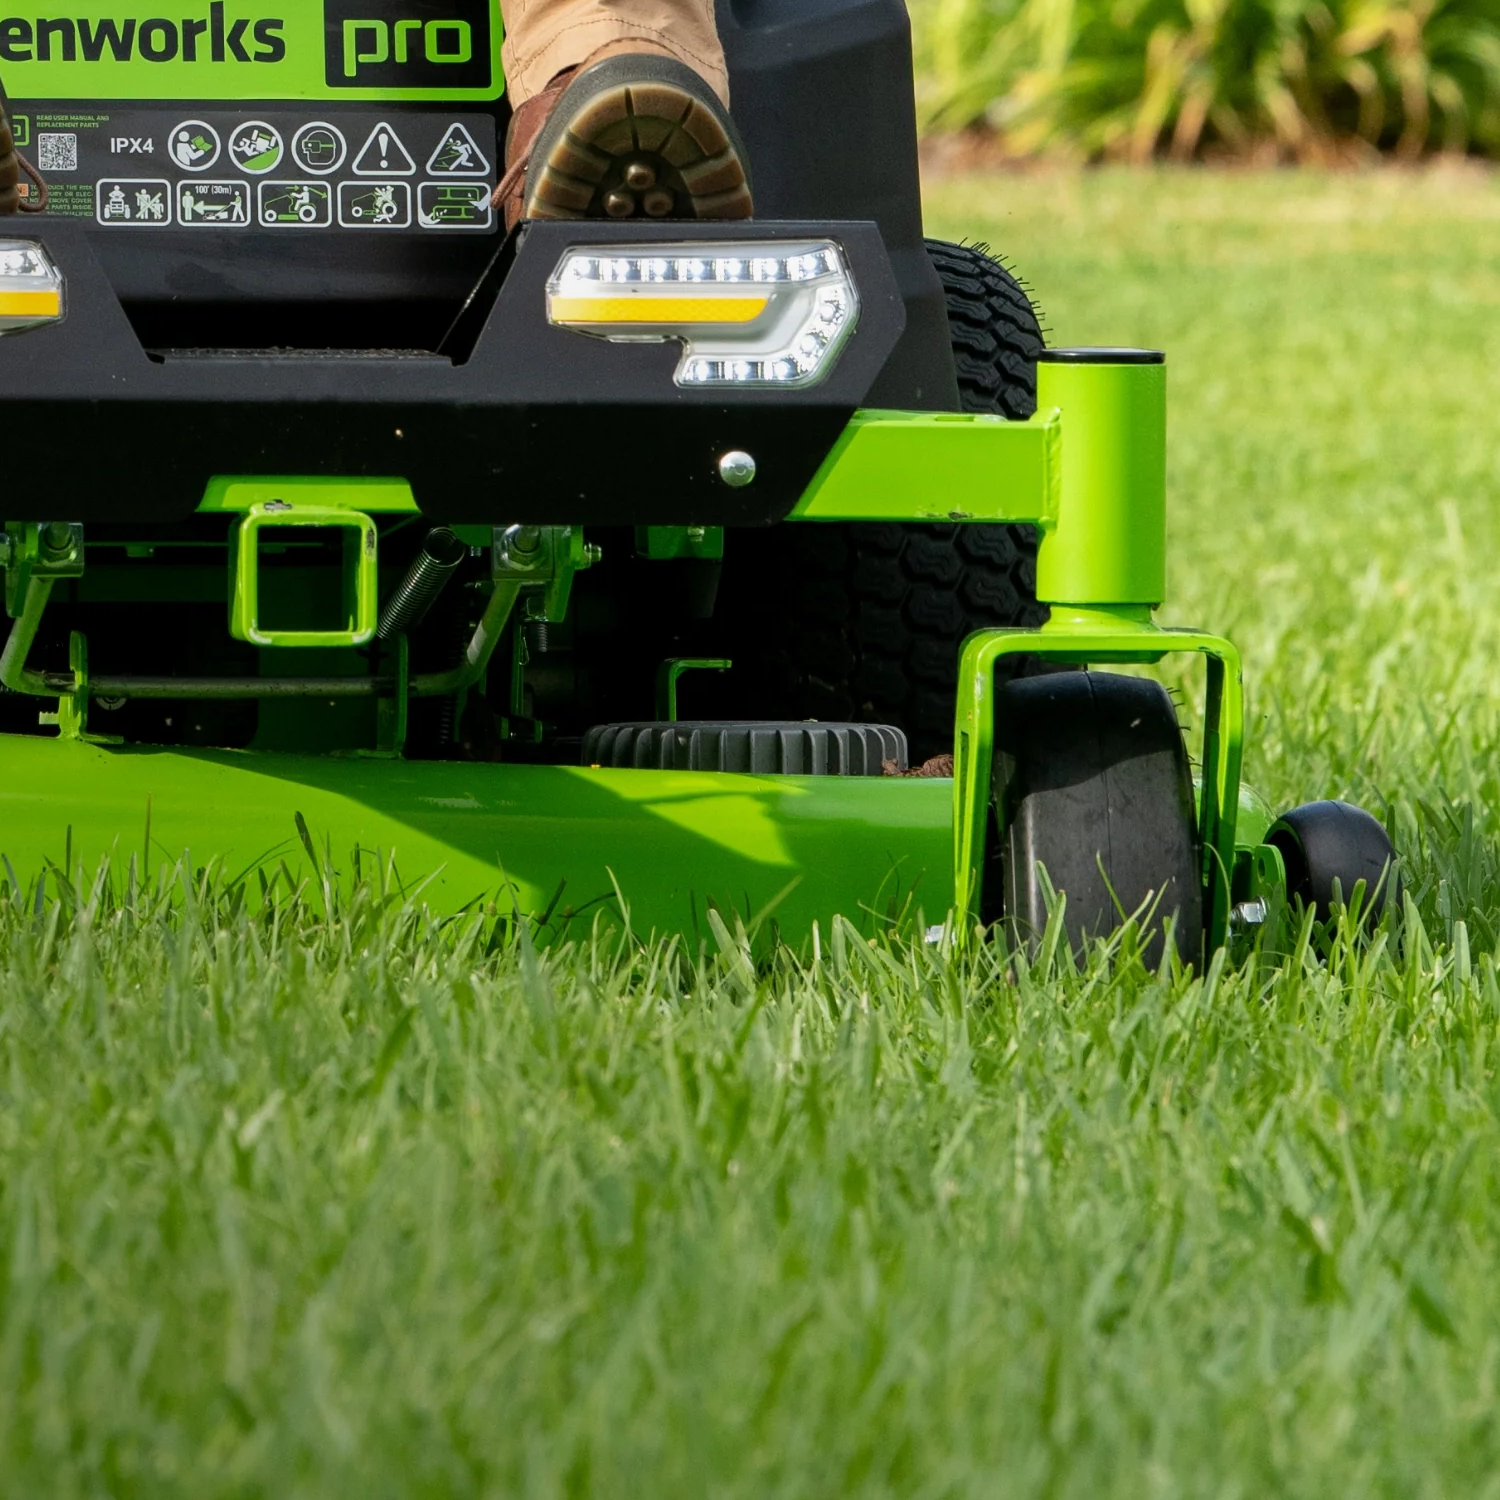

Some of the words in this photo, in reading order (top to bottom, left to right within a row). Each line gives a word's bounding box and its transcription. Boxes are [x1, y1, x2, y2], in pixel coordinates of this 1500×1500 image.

[343, 19, 472, 77] pro
[110, 137, 154, 154] IPX4
[211, 185, 232, 195] (30m)
